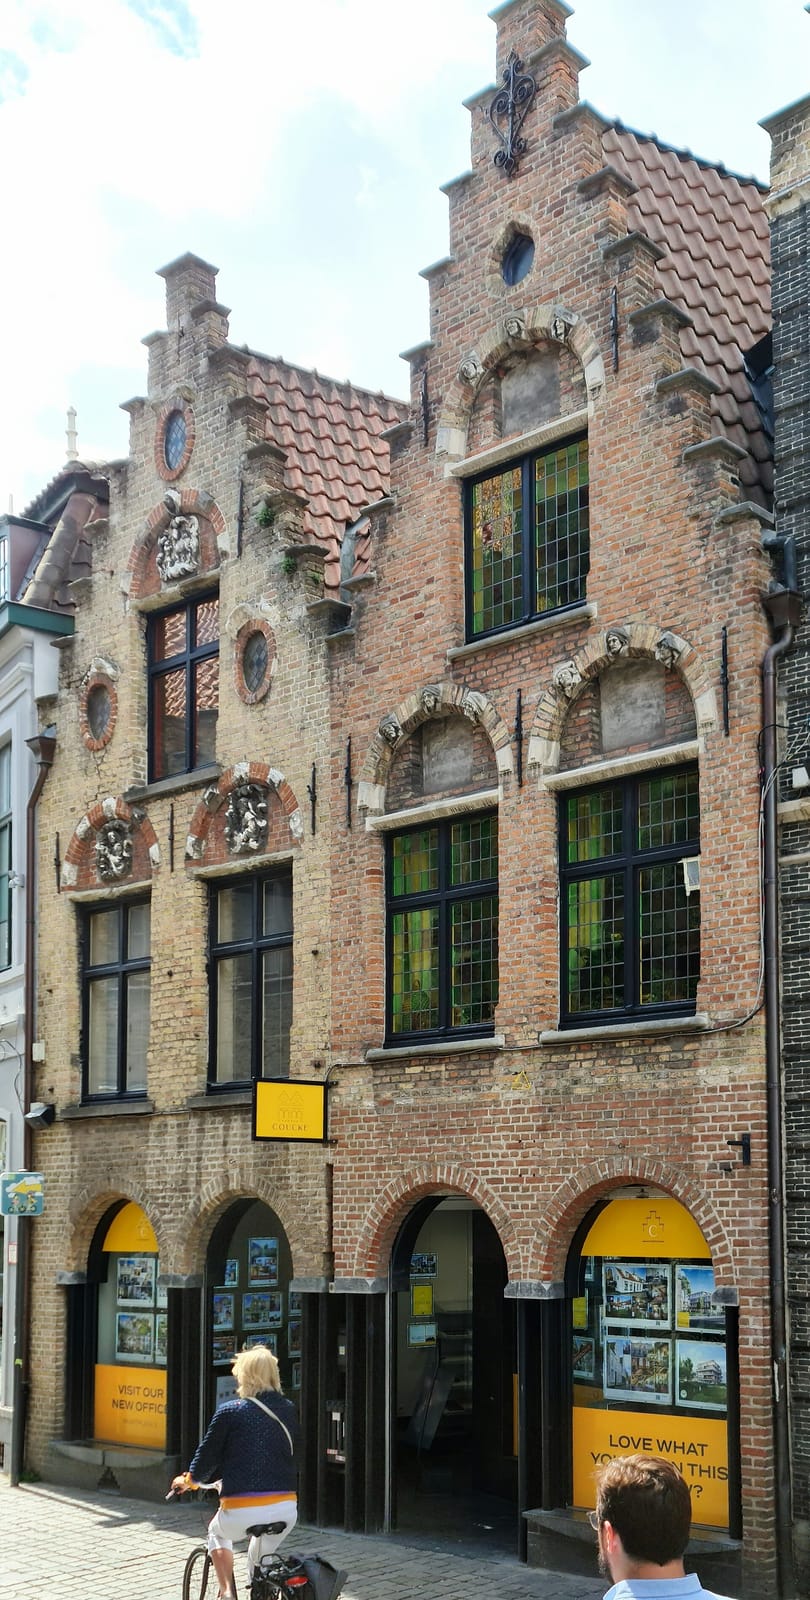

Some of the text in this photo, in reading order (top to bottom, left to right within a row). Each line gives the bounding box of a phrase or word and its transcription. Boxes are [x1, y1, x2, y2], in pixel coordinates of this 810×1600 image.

[272, 1122, 308, 1132] COUCKE
[648, 1224, 657, 1238] C
[118, 1384, 164, 1398] VISIT OUR
[112, 1399, 133, 1410] NEW
[609, 1434, 708, 1457] LOVE WHAT
[590, 1452, 616, 1465] YO
[687, 1463, 728, 1480] THIS
